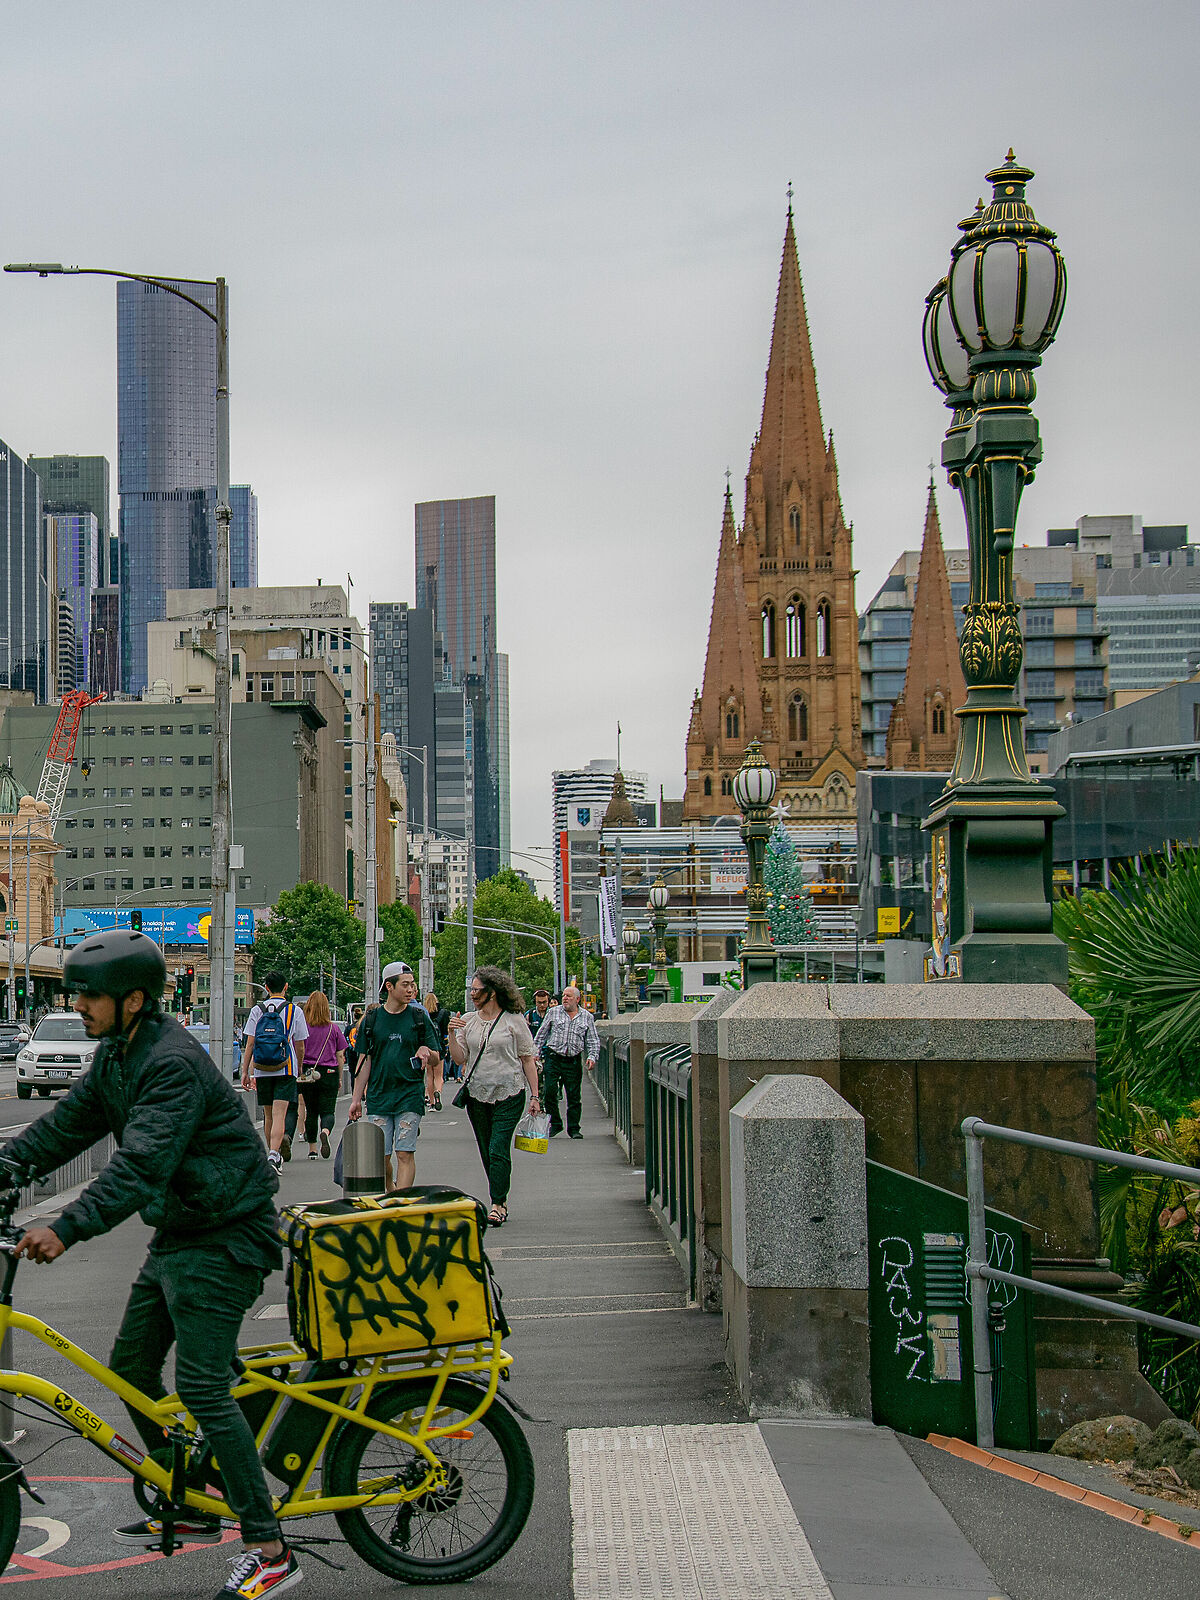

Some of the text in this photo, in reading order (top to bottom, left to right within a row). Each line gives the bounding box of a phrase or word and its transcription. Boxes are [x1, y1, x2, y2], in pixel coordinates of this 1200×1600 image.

[718, 866, 748, 875] WELCO
[715, 875, 745, 883] REFUG
[44, 1327, 70, 1350] Cargo
[74, 1406, 103, 1432] EASI
[289, 1456, 296, 1466] 7
